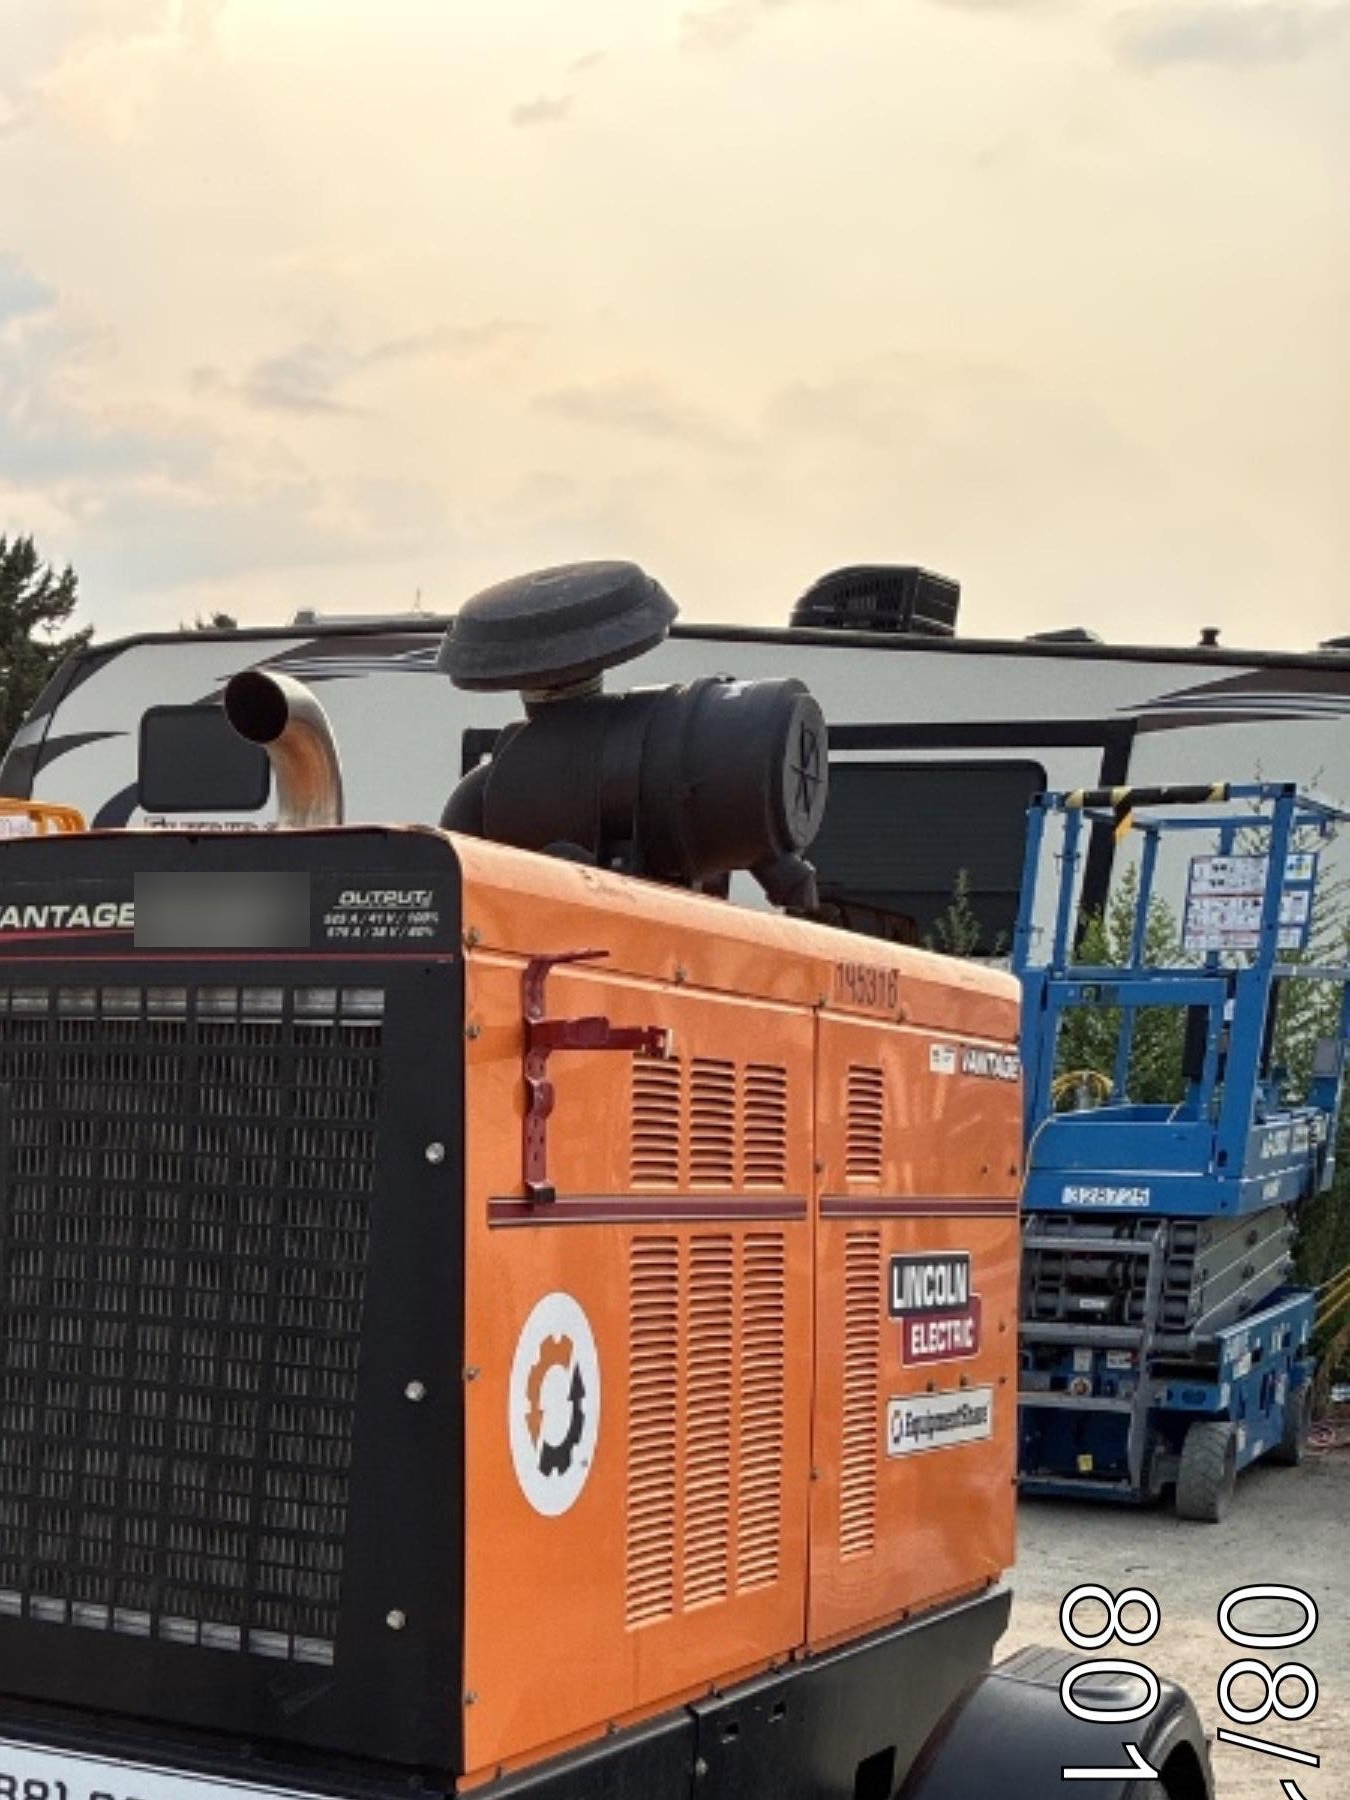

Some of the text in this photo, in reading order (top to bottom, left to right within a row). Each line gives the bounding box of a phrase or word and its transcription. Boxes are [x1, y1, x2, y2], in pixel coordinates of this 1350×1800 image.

[337, 889, 428, 905] OUTPUT
[892, 1263, 968, 1310] LINCOLN
[910, 1316, 975, 1356] ELECTRIC
